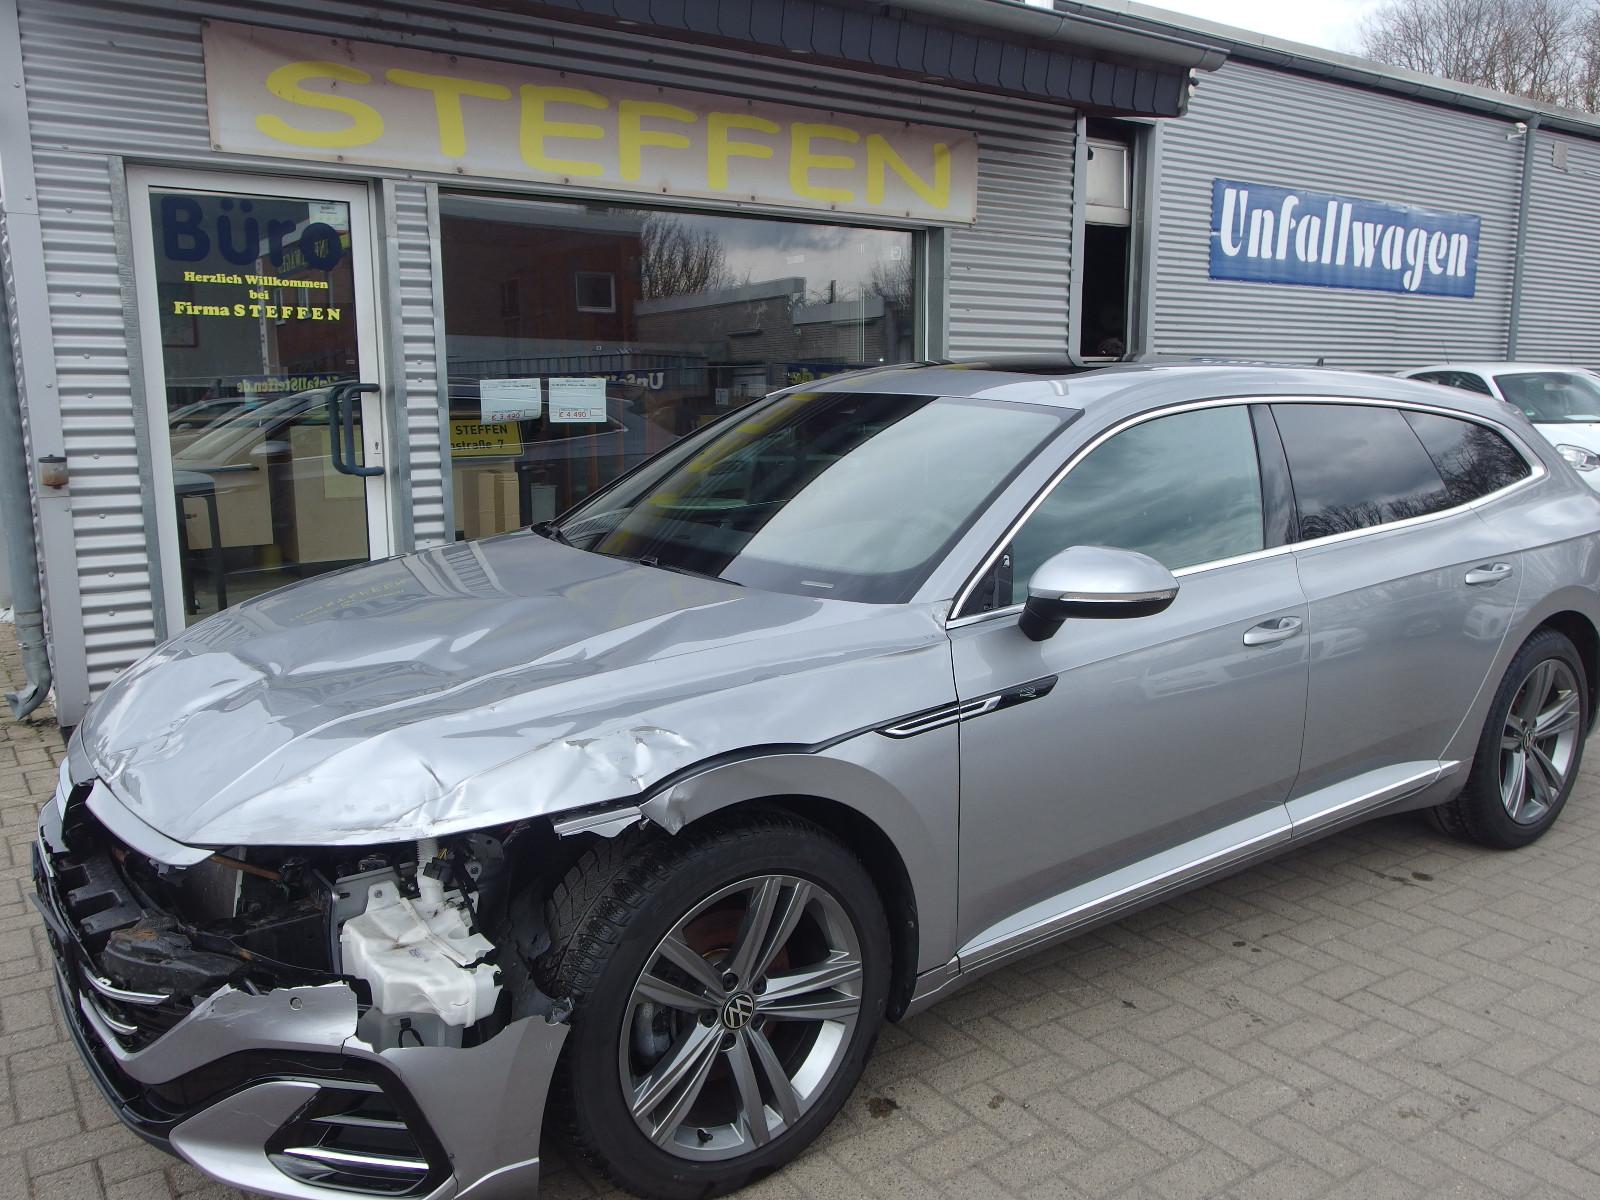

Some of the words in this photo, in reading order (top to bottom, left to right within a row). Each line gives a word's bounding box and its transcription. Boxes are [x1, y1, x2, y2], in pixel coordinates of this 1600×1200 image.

[255, 61, 951, 210] STEFFEN
[161, 196, 342, 272] Büro
[1219, 187, 1469, 292] Unfallwagen
[183, 272, 242, 285] Herzlich
[244, 274, 329, 290] Willkommen
[249, 289, 269, 301] bei
[174, 300, 230, 318] Firma
[455, 424, 508, 436] STEFFEN
